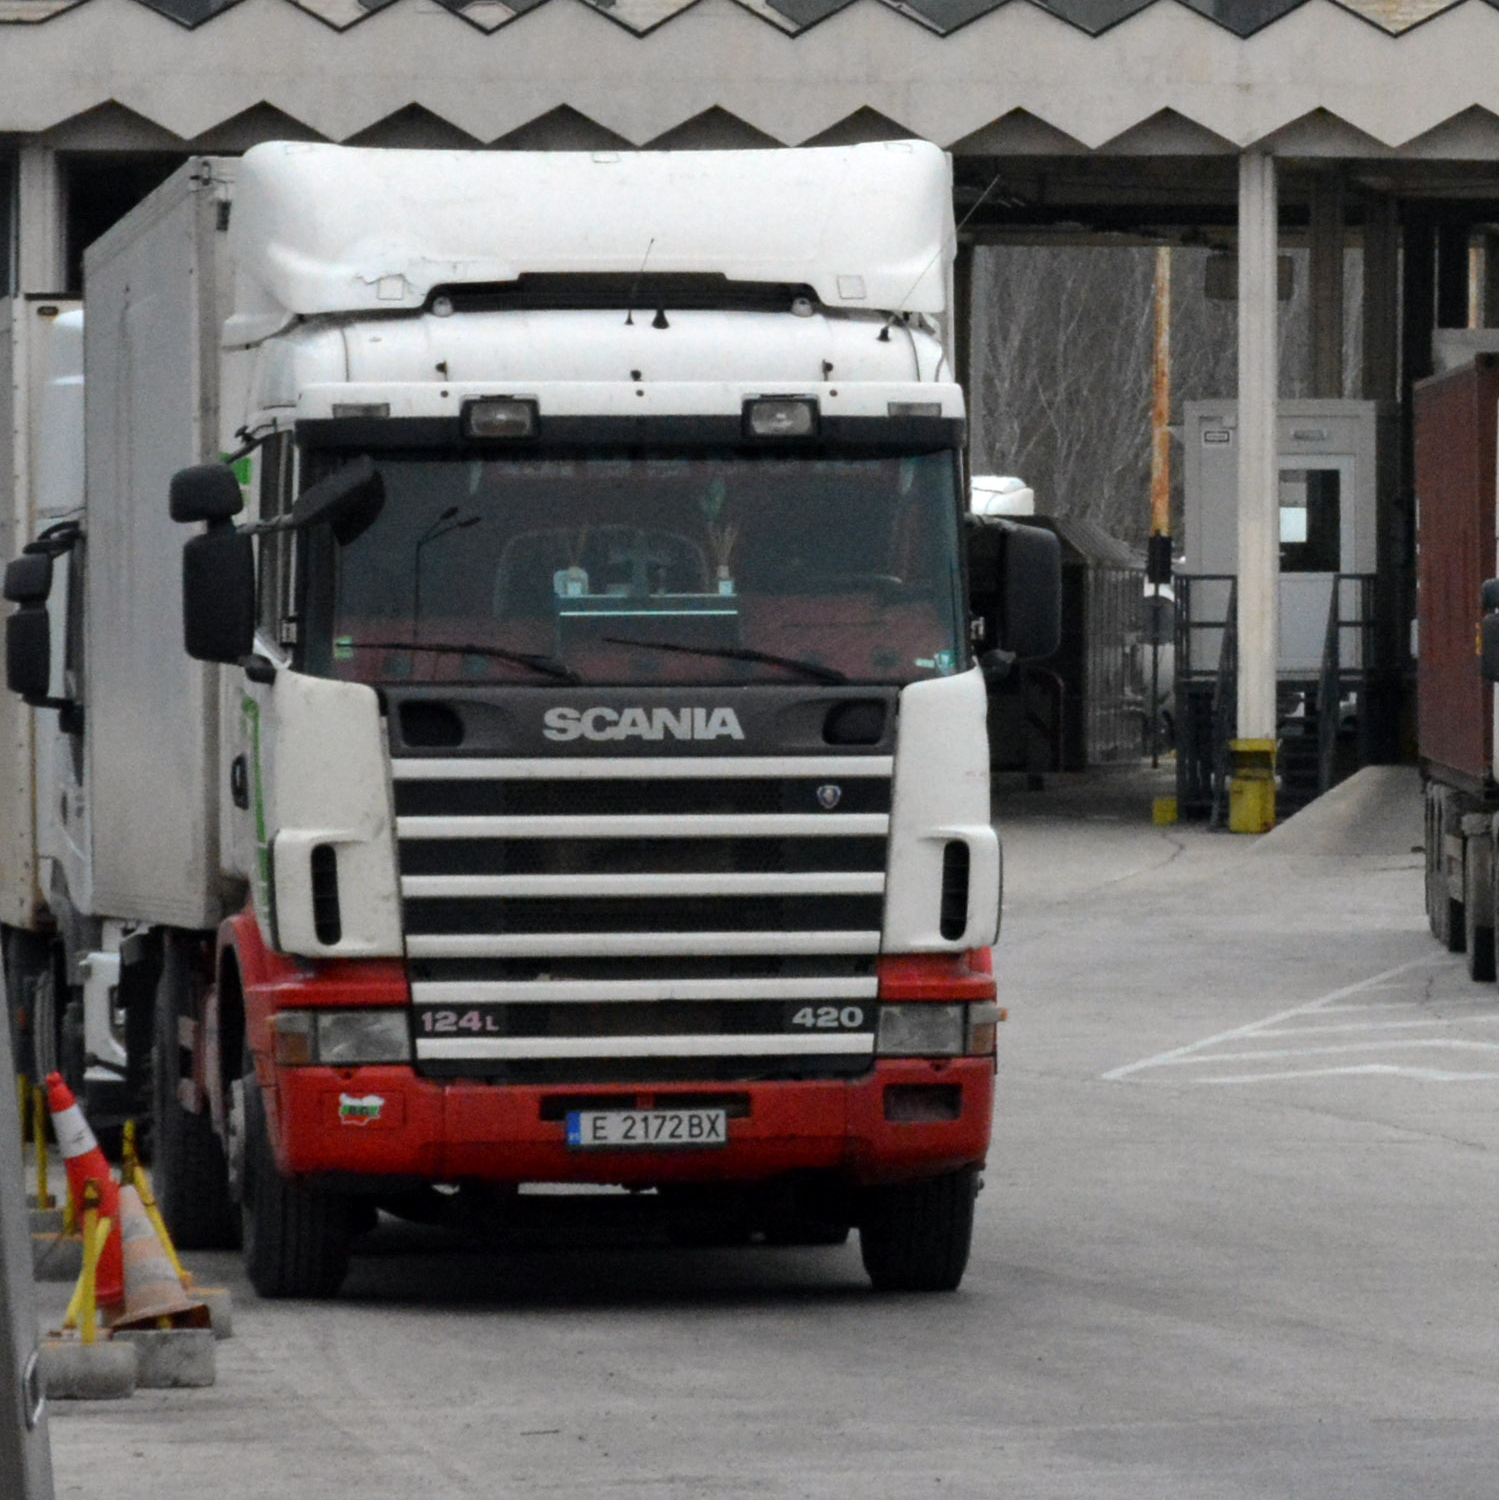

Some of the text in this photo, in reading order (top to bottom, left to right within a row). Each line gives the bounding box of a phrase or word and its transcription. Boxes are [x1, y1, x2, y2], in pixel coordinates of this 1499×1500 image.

[542, 706, 745, 741] SCANIA
[792, 1006, 864, 1027] 420
[593, 1117, 608, 1140] E
